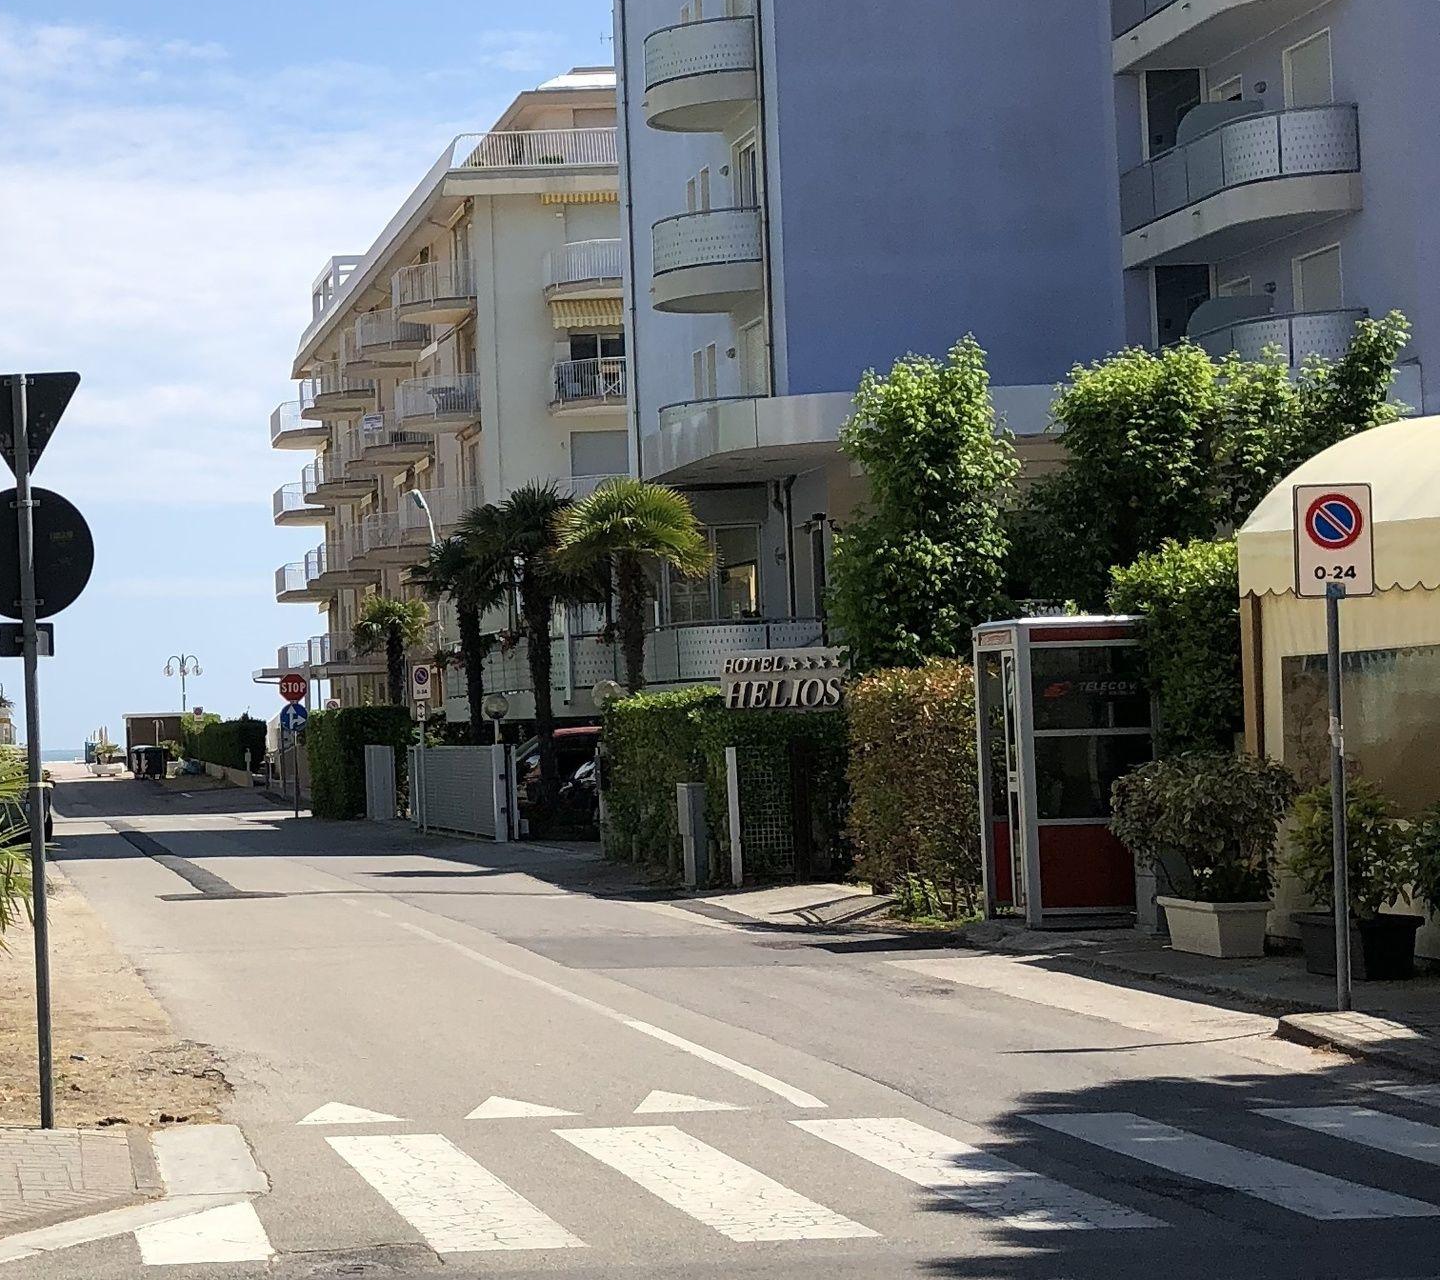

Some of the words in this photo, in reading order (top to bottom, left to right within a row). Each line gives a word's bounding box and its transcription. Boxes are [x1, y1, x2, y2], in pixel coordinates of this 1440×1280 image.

[1313, 565, 1357, 580] 0-24
[722, 656, 787, 674] HOTEL
[281, 682, 307, 693] STOP
[725, 676, 842, 709] HELIOS
